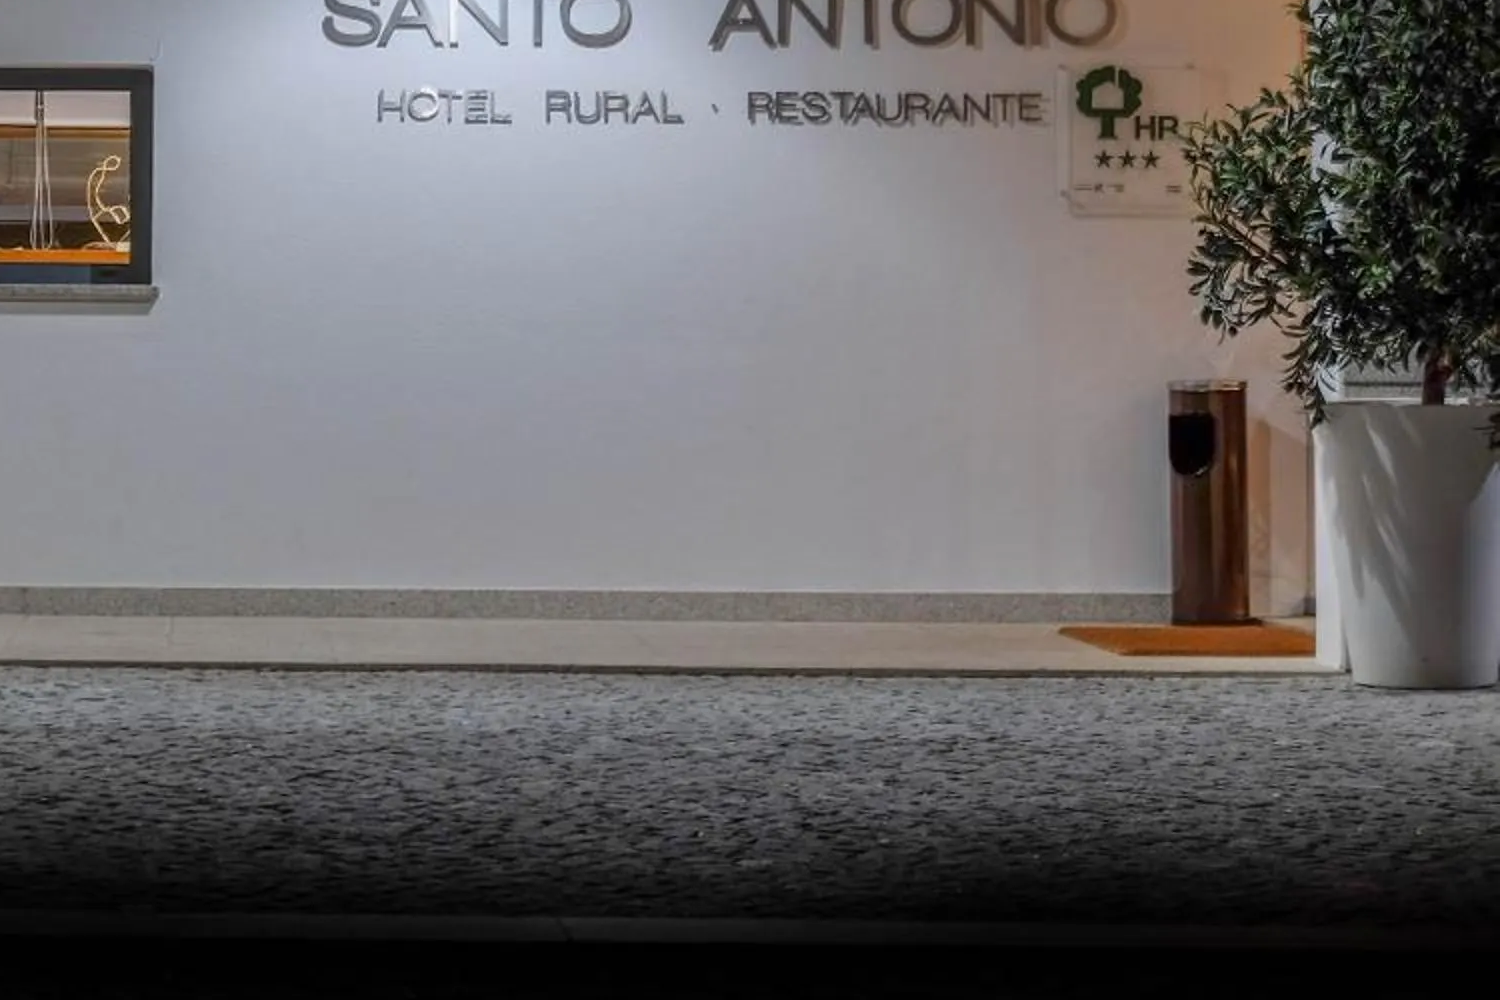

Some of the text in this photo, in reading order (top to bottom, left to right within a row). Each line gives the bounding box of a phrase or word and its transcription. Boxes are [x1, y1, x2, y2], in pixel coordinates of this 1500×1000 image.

[376, 86, 1045, 126] HOTEL RURAL RESTAURANTE
[1134, 115, 1180, 141] HR
